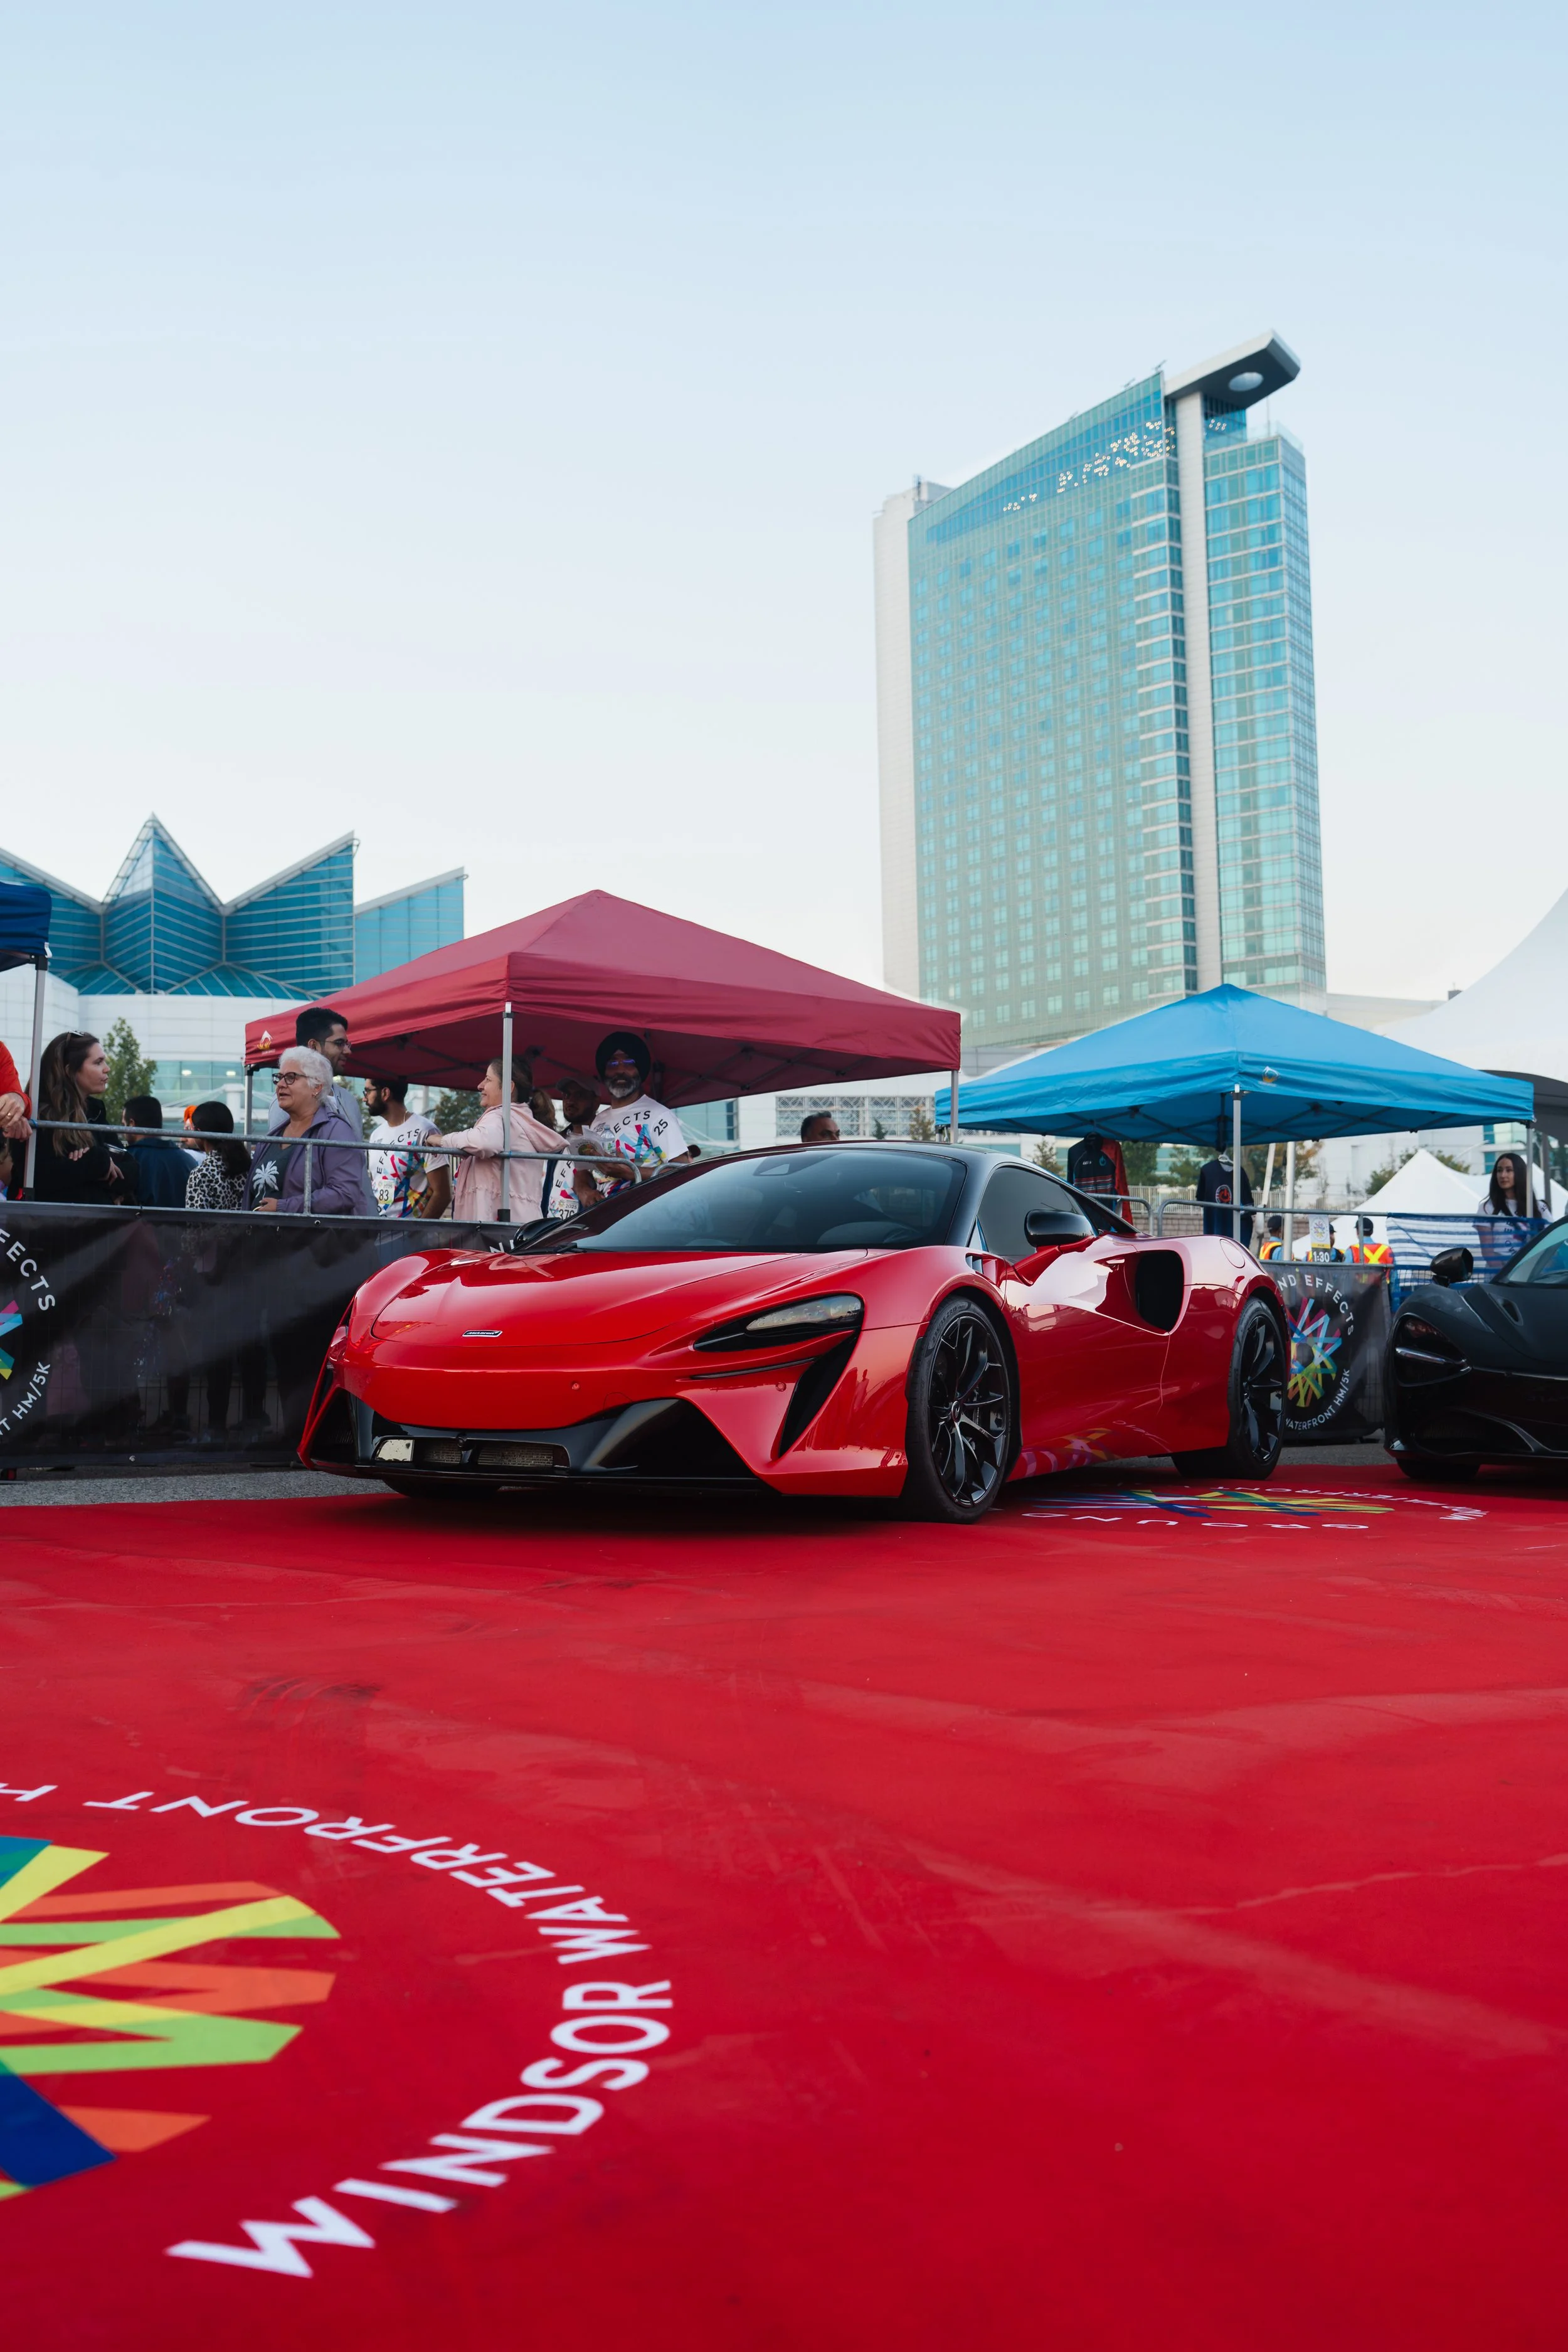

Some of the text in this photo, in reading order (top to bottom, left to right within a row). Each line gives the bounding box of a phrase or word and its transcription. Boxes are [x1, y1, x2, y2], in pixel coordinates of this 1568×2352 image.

[654, 1119, 669, 1136] 25
[379, 1189, 389, 1201] 83
[1313, 1251, 1330, 1263] 1:30
[1305, 1274, 1353, 1335] EFFECTS
[12, 1362, 50, 1419] HM/5K
[1333, 1369, 1350, 1406] HM/5K
[1021, 1513, 1369, 1529] GROUND
[83, 1791, 651, 1964] WATERFRONT
[165, 1980, 673, 2277] WINDSOR
